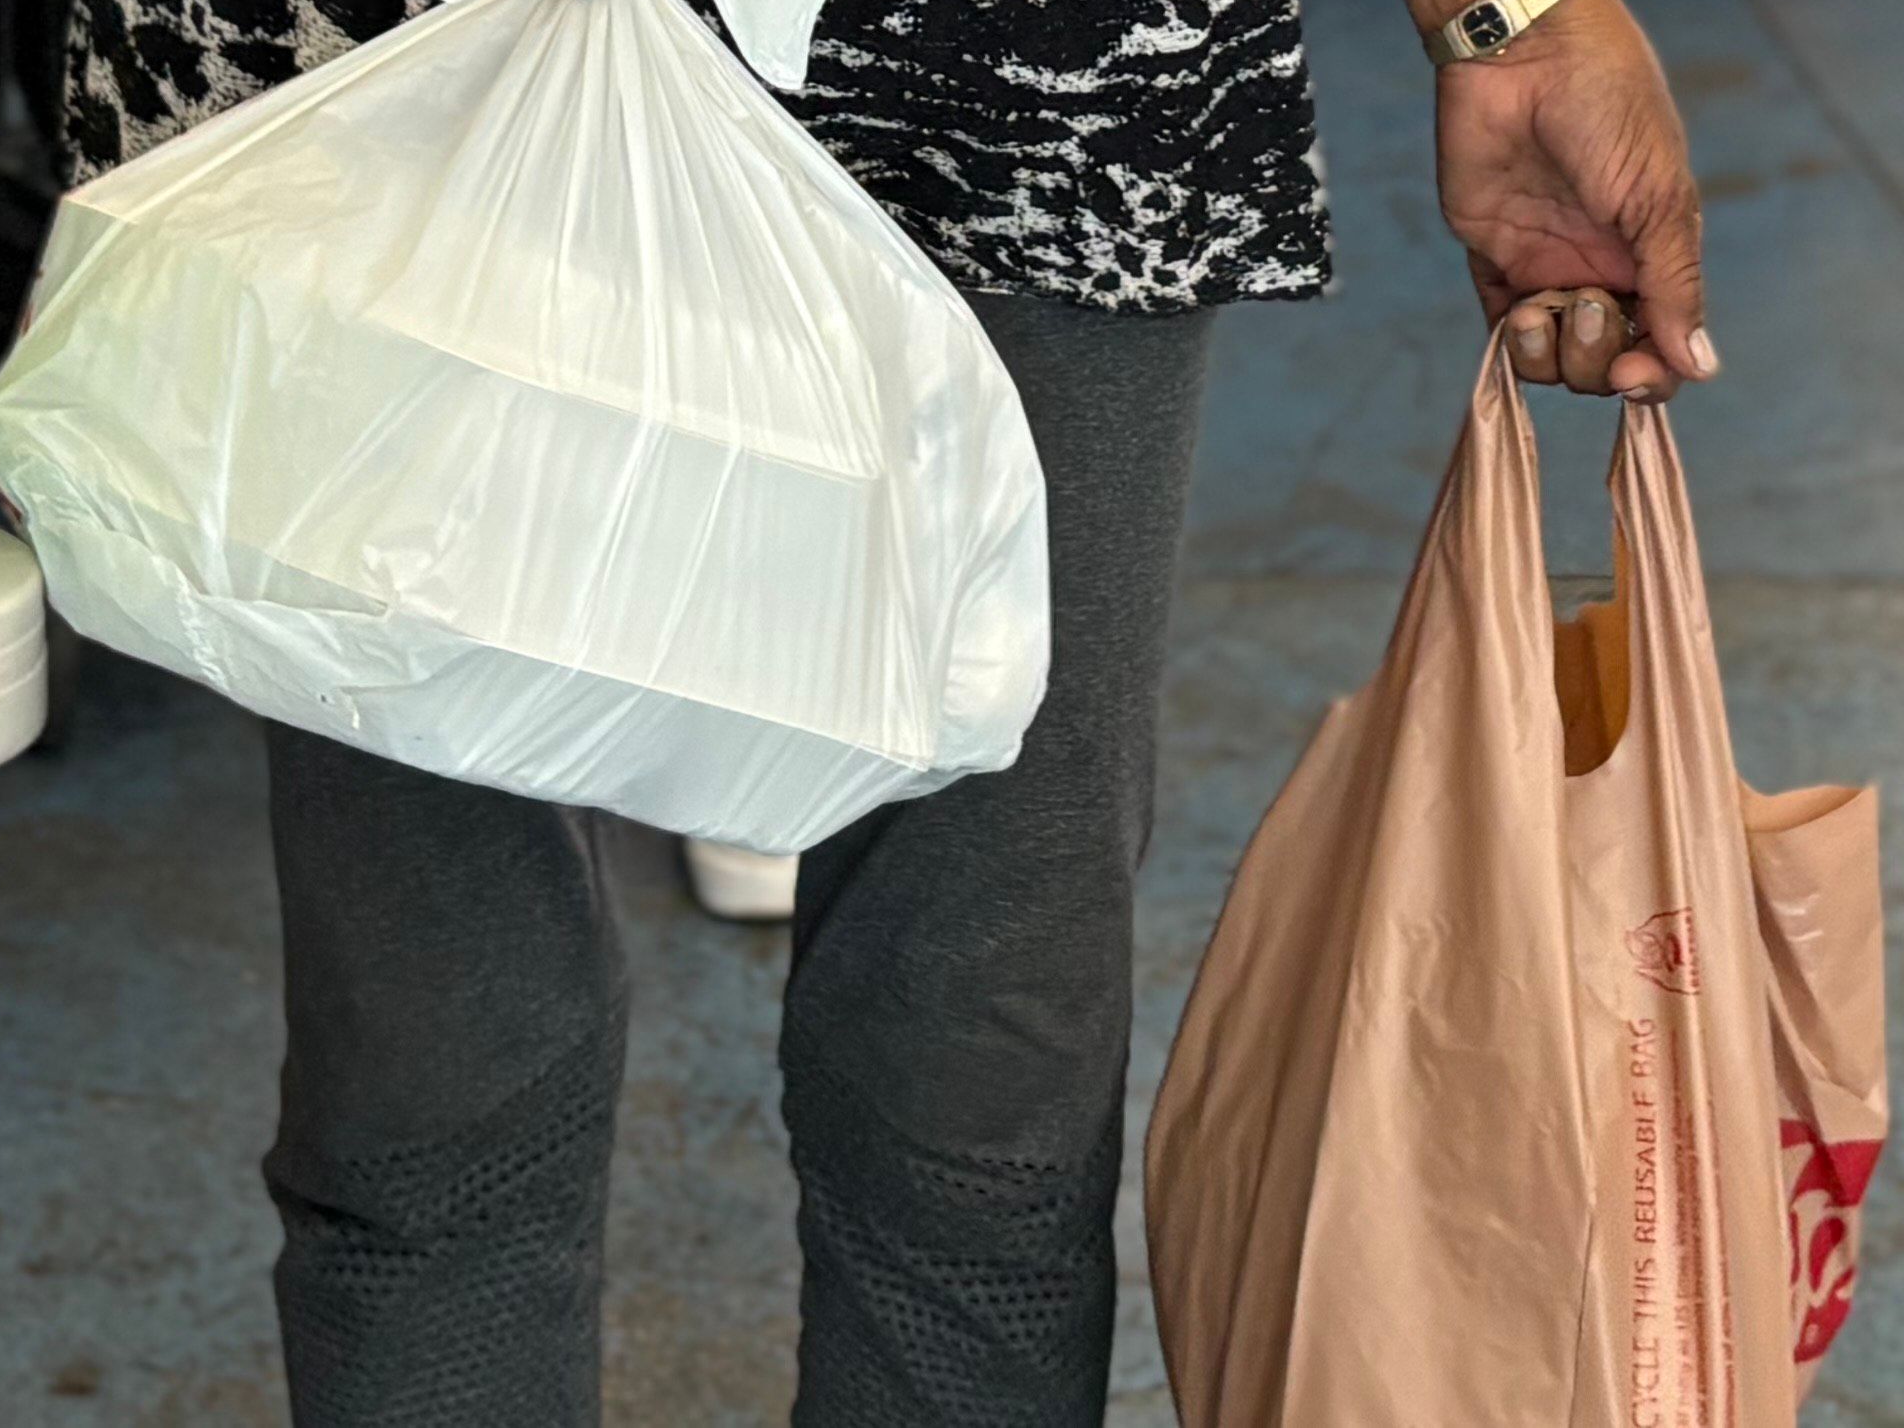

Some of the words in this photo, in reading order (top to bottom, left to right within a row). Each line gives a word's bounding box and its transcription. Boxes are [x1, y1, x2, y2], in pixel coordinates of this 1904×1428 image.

[1628, 1017, 1657, 1078] BAG
[1632, 1090, 1658, 1244] REUSABLE
[1632, 1256, 1658, 1323] THIS
